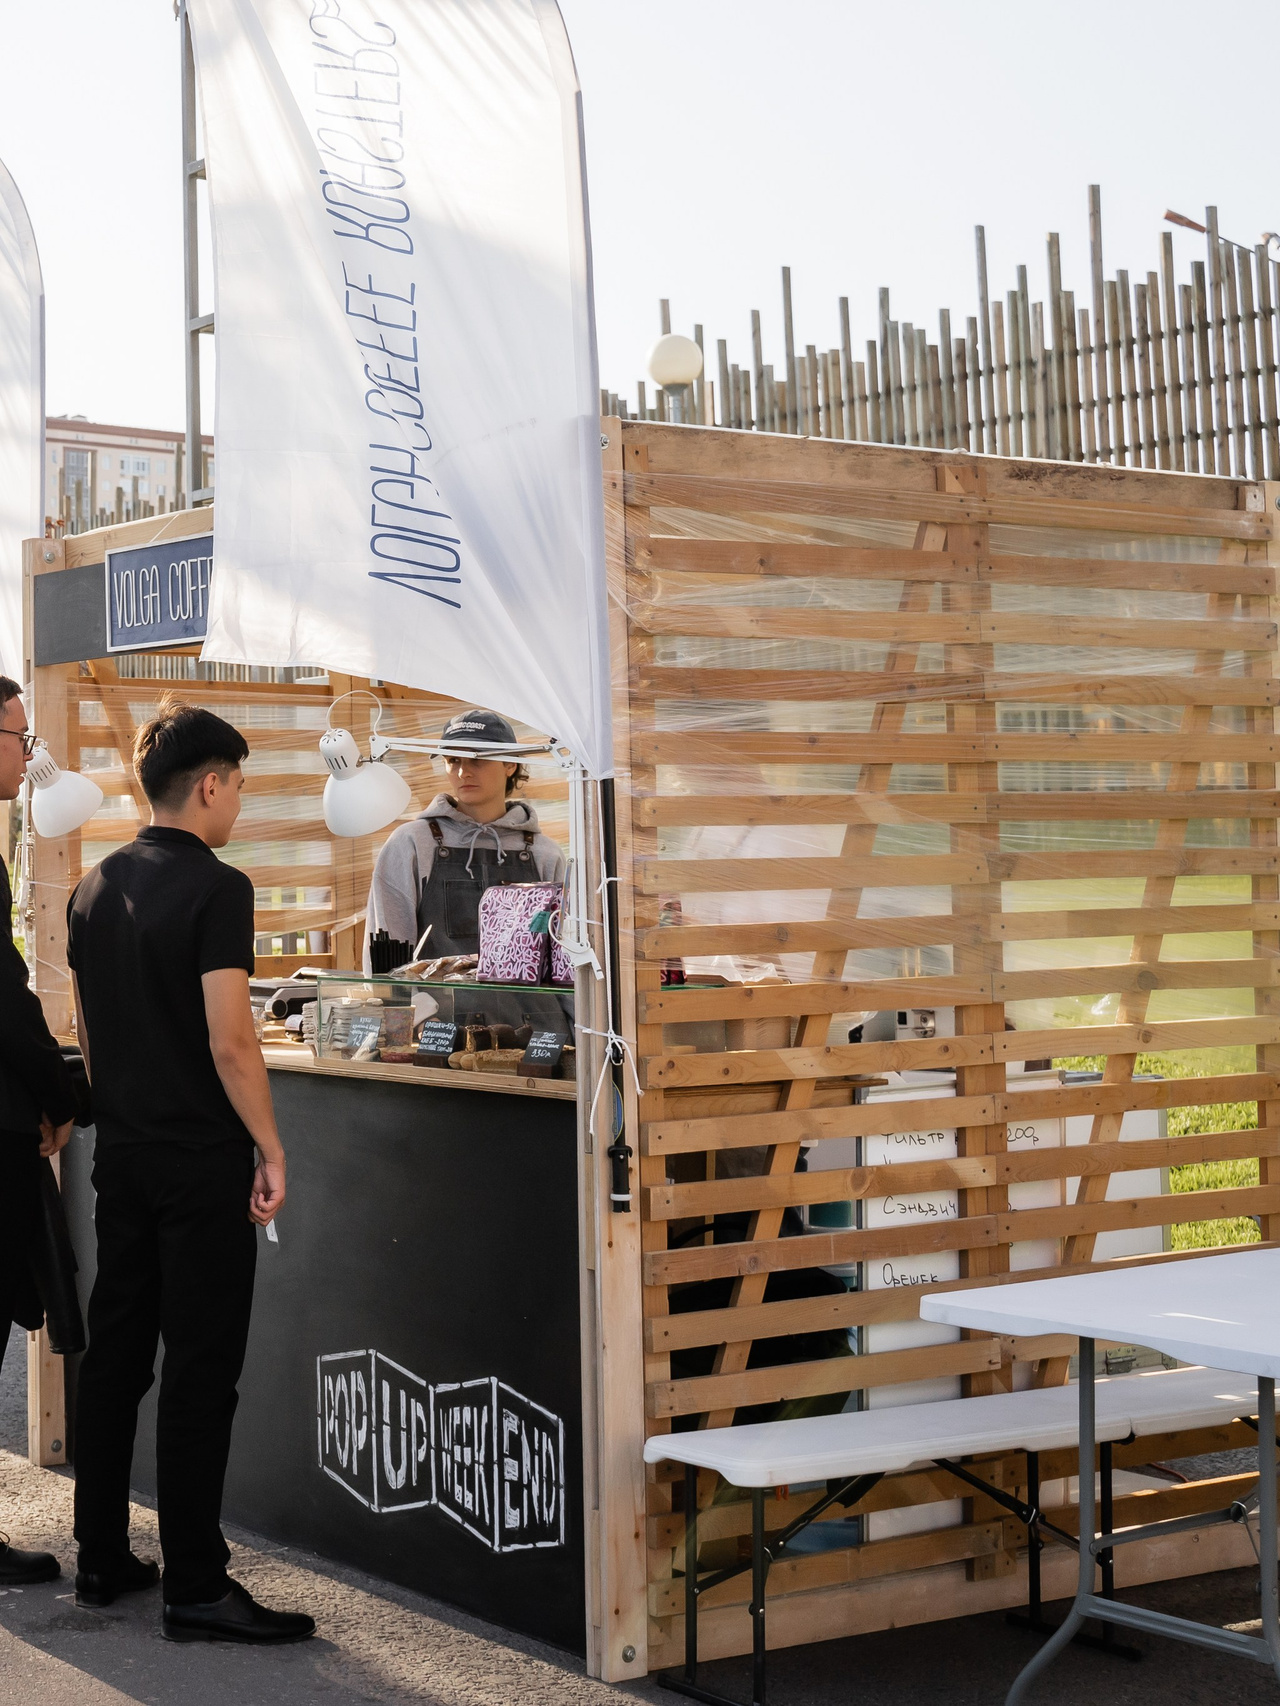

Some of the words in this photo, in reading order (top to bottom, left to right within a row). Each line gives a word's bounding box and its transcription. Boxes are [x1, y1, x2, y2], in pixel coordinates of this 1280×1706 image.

[113, 564, 162, 629] VOLGA
[324, 1370, 368, 1476] POP
[382, 1379, 428, 1490] UP
